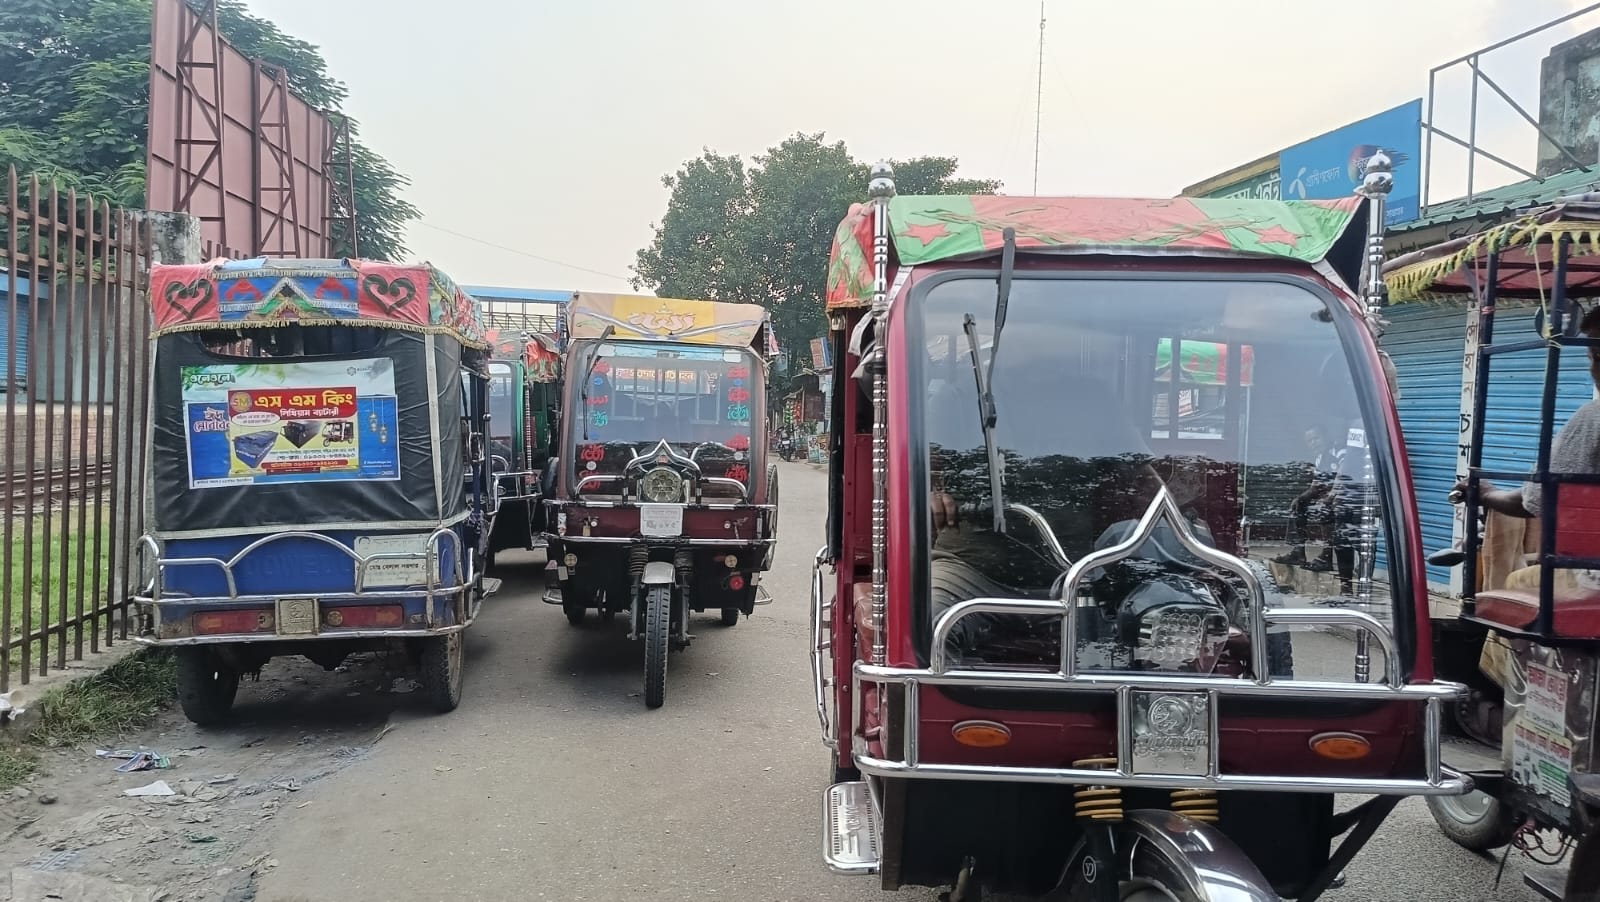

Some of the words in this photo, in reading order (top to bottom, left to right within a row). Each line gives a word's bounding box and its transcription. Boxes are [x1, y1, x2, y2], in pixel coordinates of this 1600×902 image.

[254, 395, 282, 408] এস
[288, 394, 316, 407] এম
[322, 390, 353, 406] কিং
